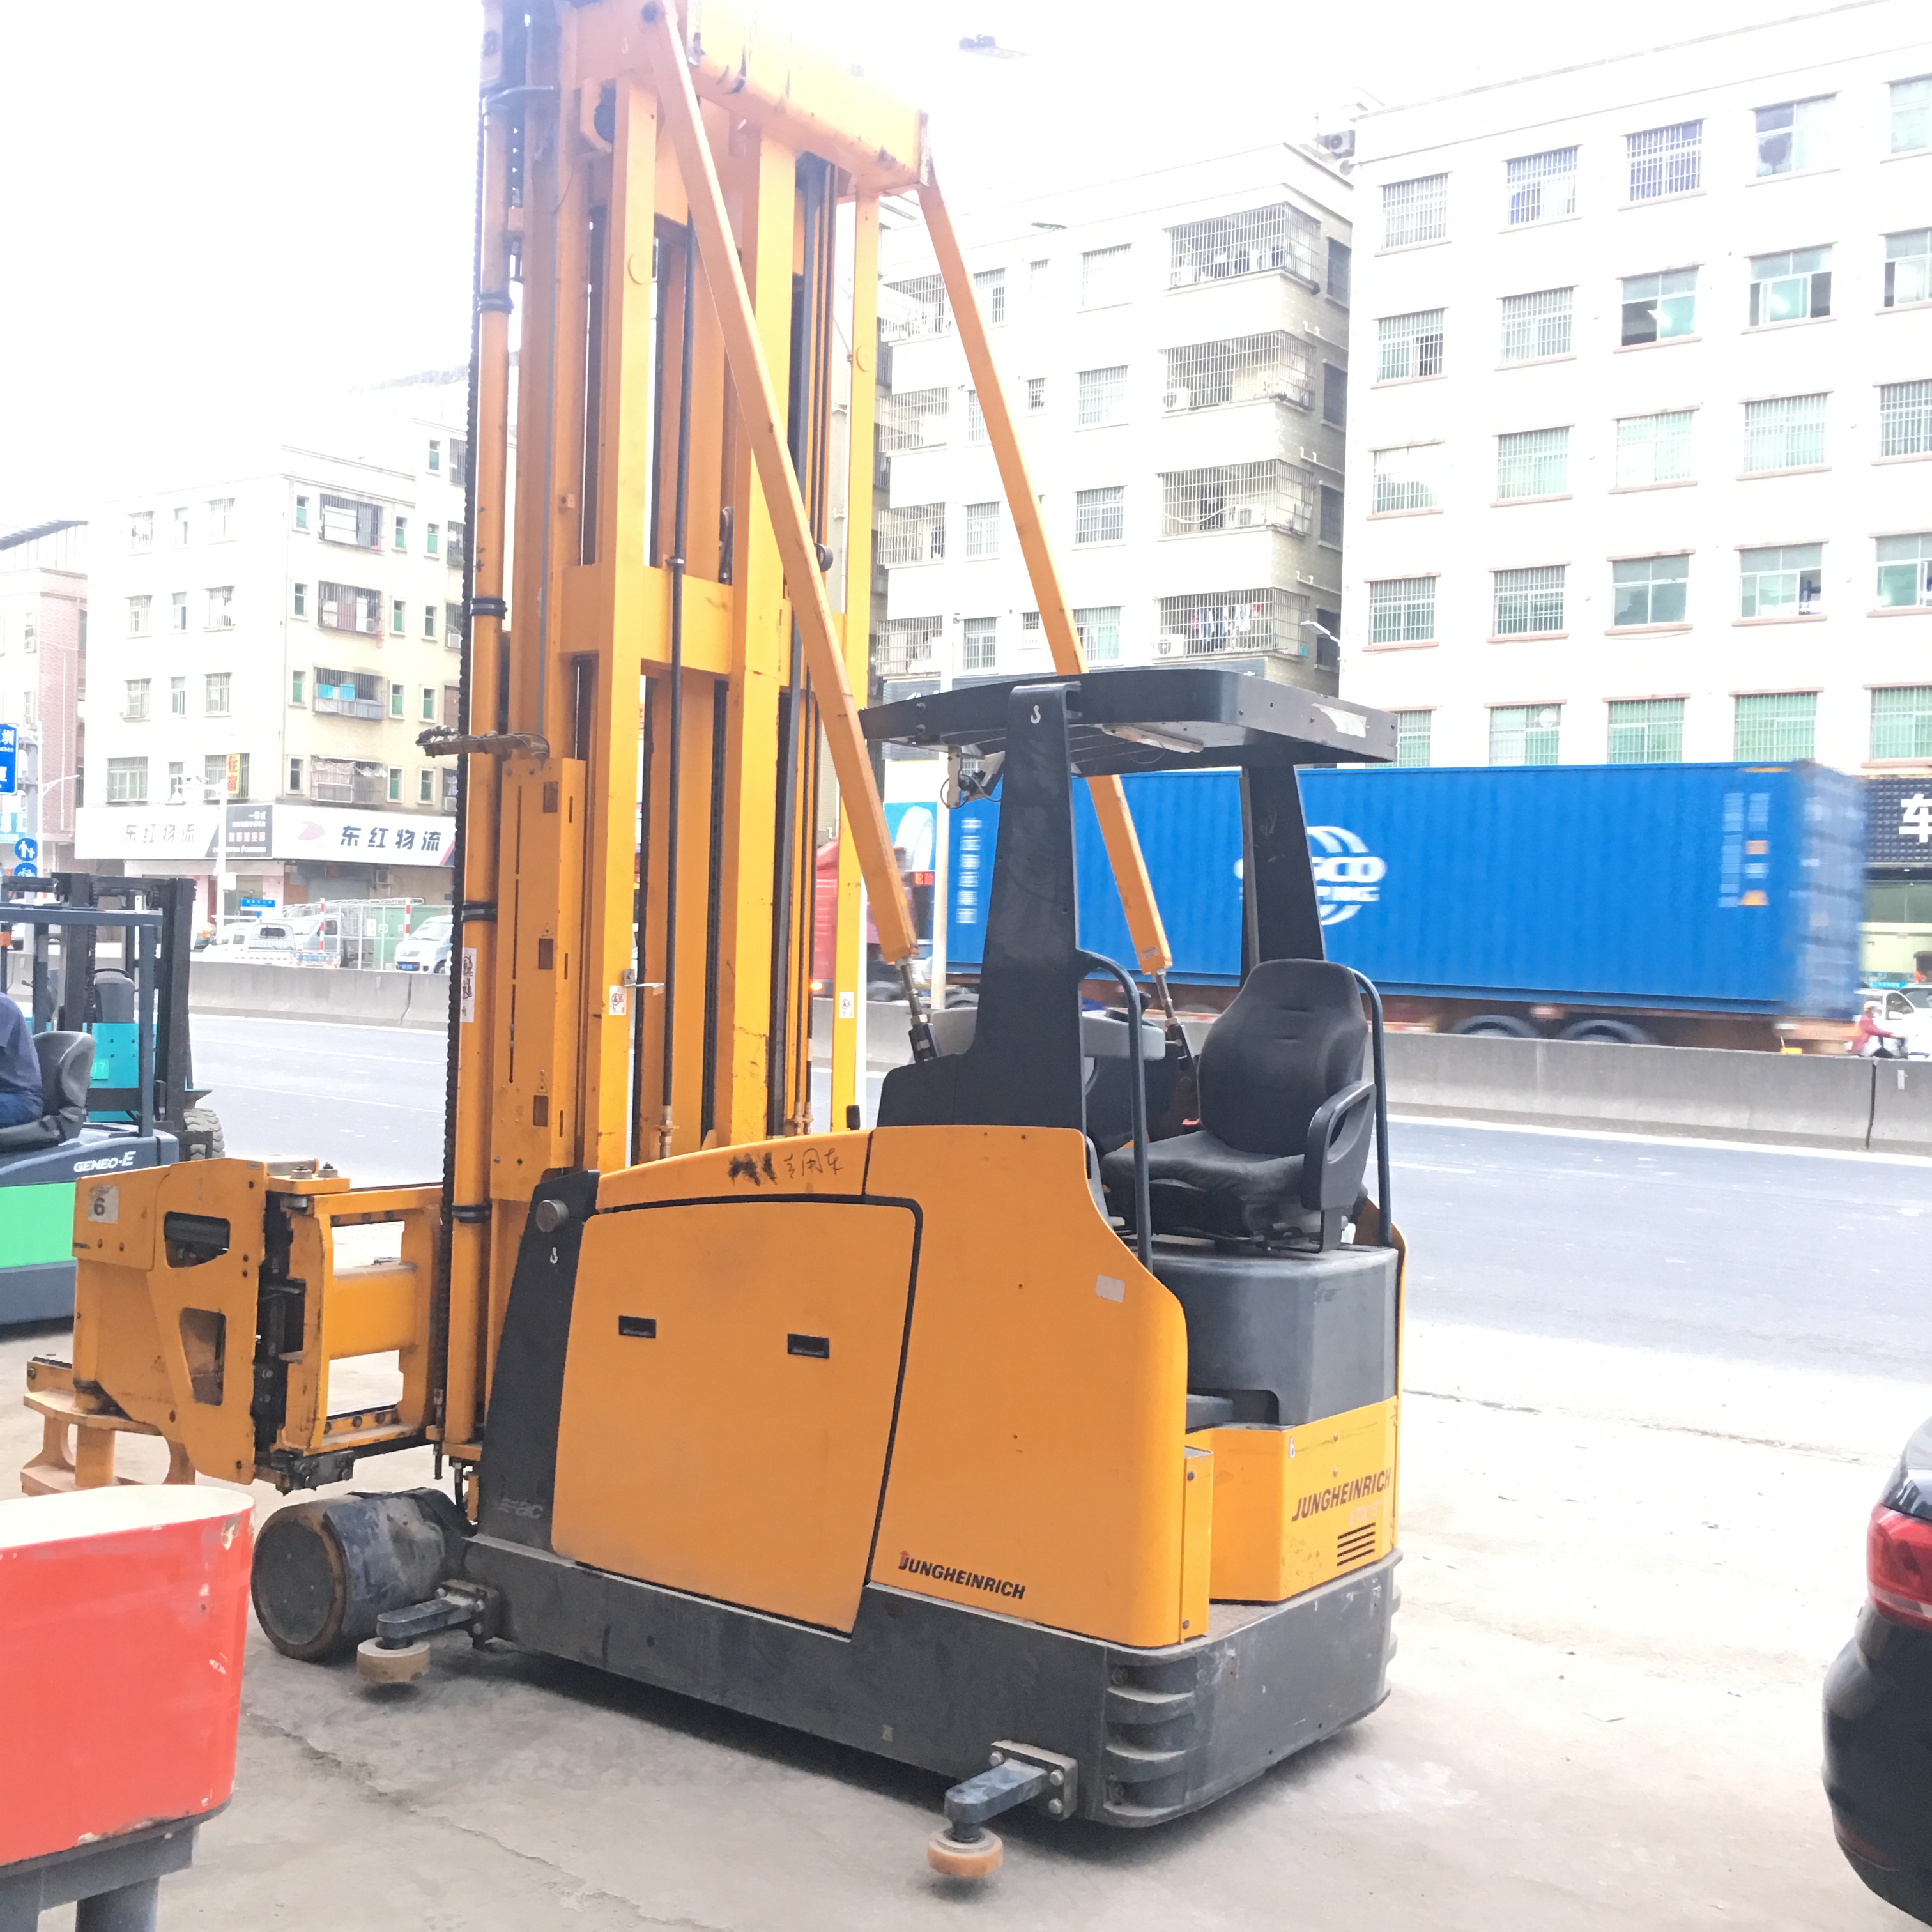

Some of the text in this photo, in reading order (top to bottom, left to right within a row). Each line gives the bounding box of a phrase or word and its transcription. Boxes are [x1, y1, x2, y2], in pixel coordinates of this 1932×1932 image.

[0, 729, 15, 746] 圳
[227, 755, 238, 792] 住宿
[124, 823, 195, 843] 东红物流
[340, 825, 442, 852] 东红物流
[73, 1151, 136, 1173] GENEO-E
[94, 1197, 105, 1216] 6
[1291, 1466, 1392, 1522] JUNGHEINRICH
[898, 1556, 1026, 1599] JUNGHEINRICH
